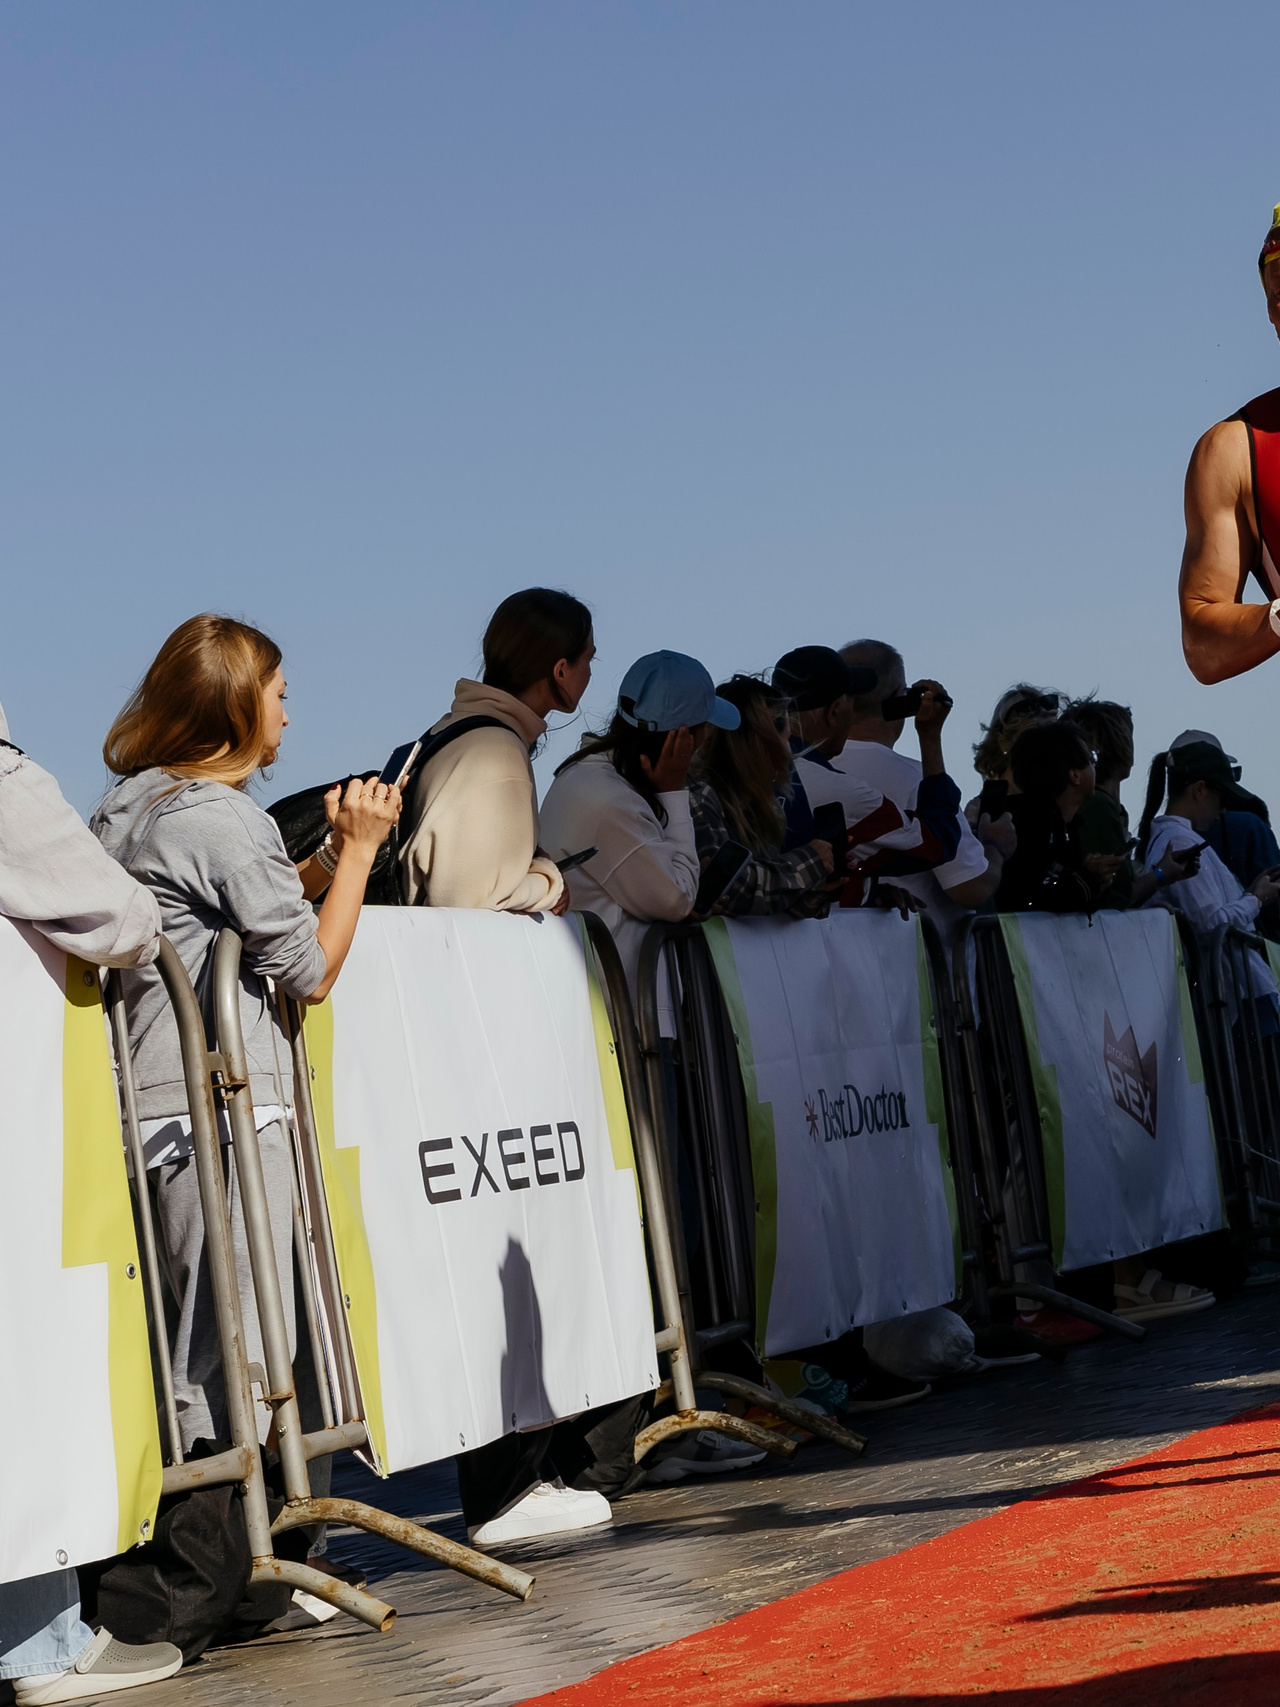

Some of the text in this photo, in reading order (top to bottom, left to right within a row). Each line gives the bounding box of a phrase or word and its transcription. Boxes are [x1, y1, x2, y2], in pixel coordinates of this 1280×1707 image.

[817, 1083, 910, 1143] BestDoctor
[1106, 1059, 1155, 1134] REX
[418, 1120, 586, 1205] EXEED
